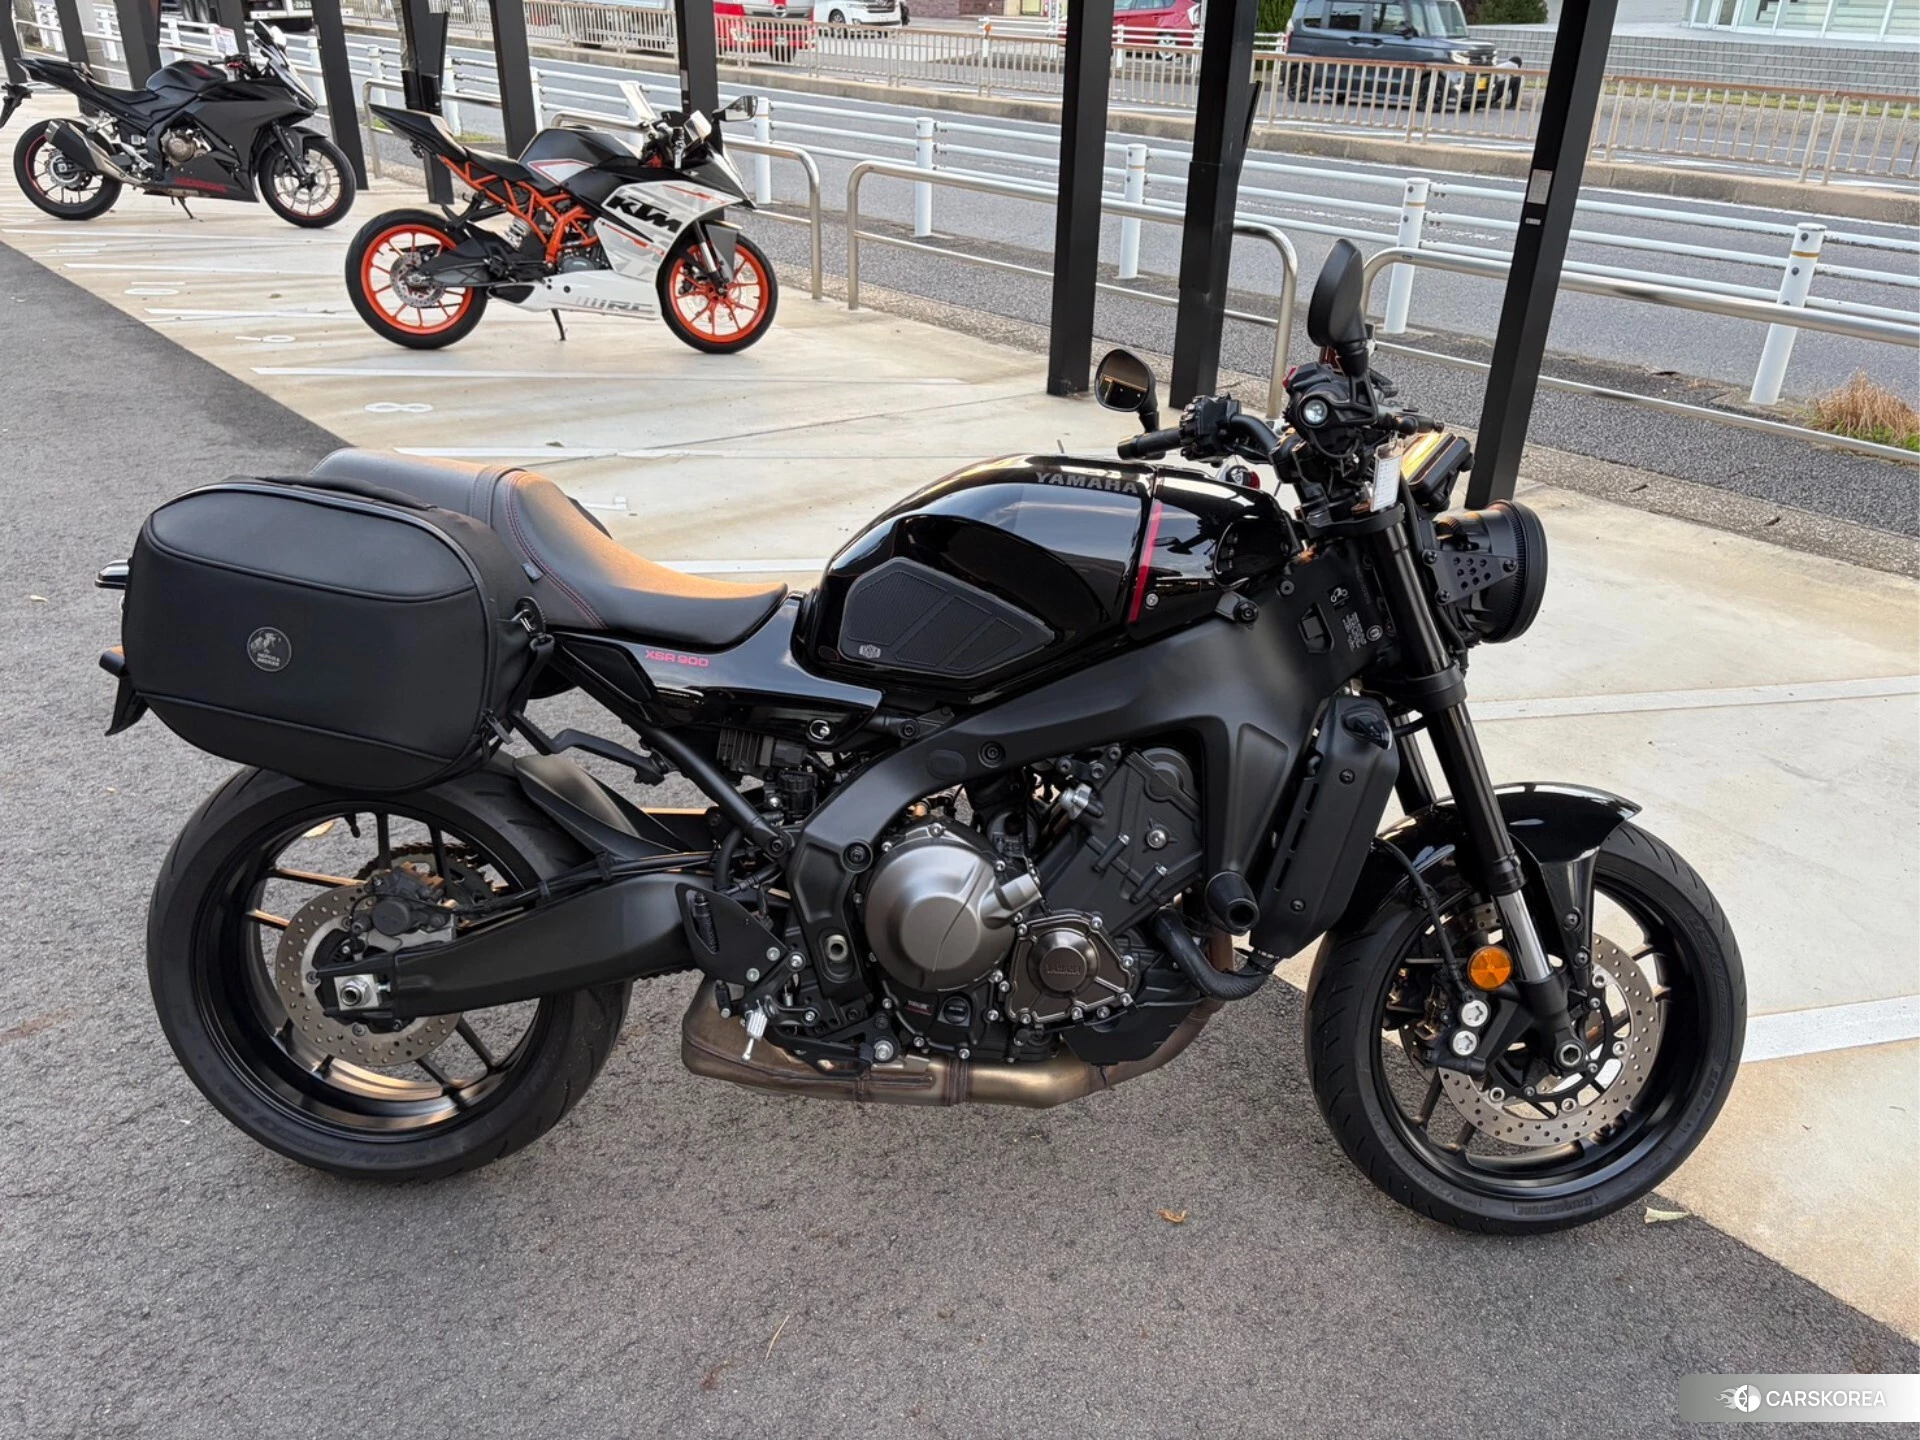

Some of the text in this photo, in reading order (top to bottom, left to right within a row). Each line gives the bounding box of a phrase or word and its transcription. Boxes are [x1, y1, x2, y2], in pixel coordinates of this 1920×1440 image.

[605, 195, 684, 234] KTM
[364, 401, 434, 413] 8
[1034, 471, 1139, 495] YAMAHA
